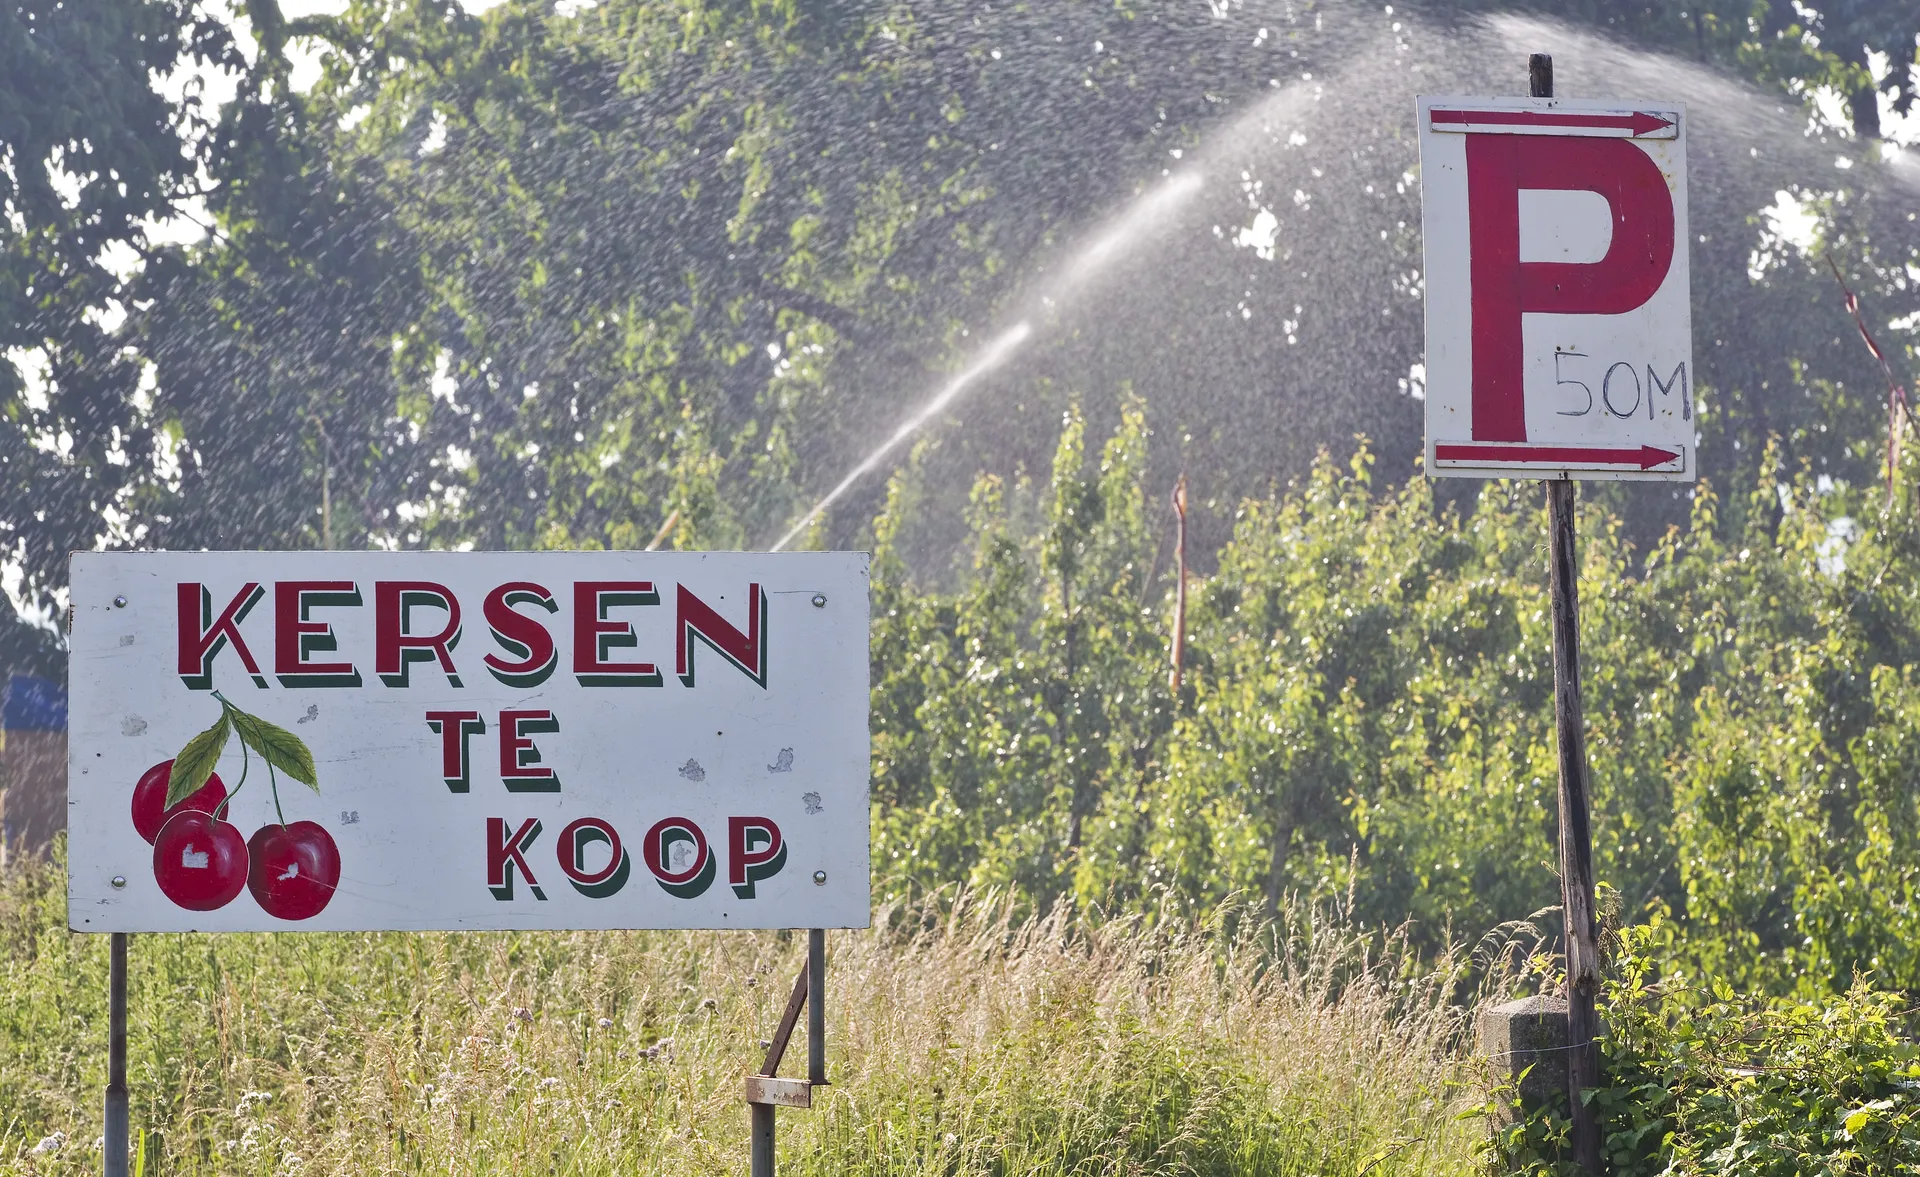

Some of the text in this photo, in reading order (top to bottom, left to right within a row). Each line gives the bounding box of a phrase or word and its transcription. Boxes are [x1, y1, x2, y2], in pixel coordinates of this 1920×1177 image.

[1465, 133, 1675, 442] P
[1554, 351, 1691, 421] 50M
[177, 581, 768, 690] KERSEN
[425, 709, 561, 793] TE
[485, 816, 788, 901] KOOP
